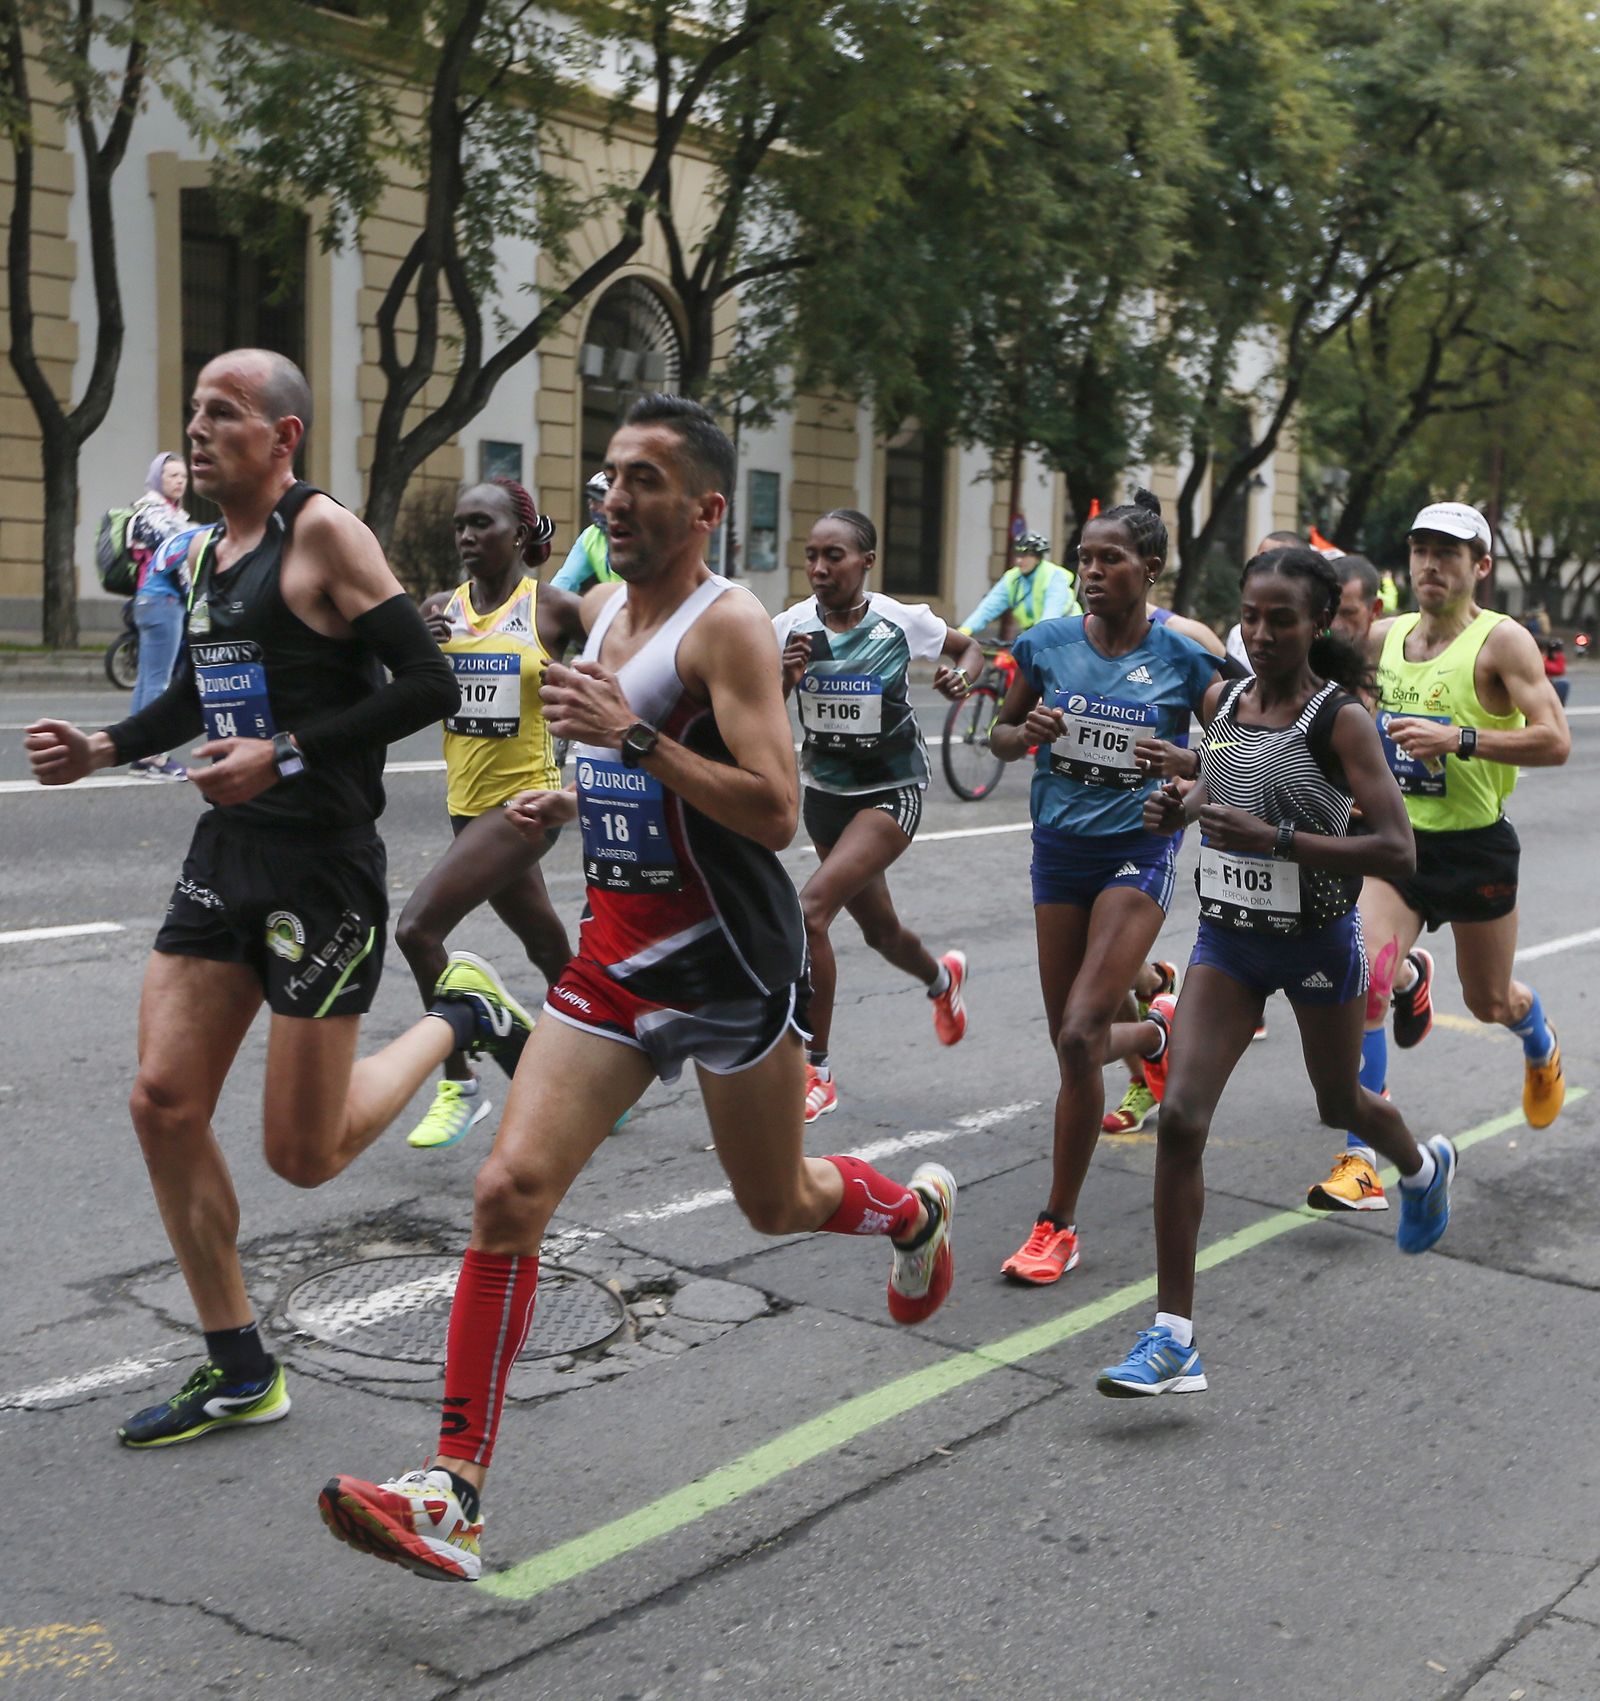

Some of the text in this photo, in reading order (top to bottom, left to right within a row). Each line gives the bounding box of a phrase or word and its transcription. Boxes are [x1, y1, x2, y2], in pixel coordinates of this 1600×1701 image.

[868, 631, 896, 640] adidas
[458, 658, 508, 672] ZURICH
[205, 674, 252, 692] ZURICH
[822, 680, 871, 692] ZURICH
[816, 703, 861, 720] F106
[1089, 702, 1146, 722] ZURICH
[214, 712, 237, 738] 84
[1078, 726, 1130, 753] F105
[595, 770, 647, 792] ZURICH
[601, 812, 630, 842] 18
[596, 847, 638, 862] CARRETERO
[1223, 863, 1273, 893] F103
[1250, 896, 1273, 906] DIDA
